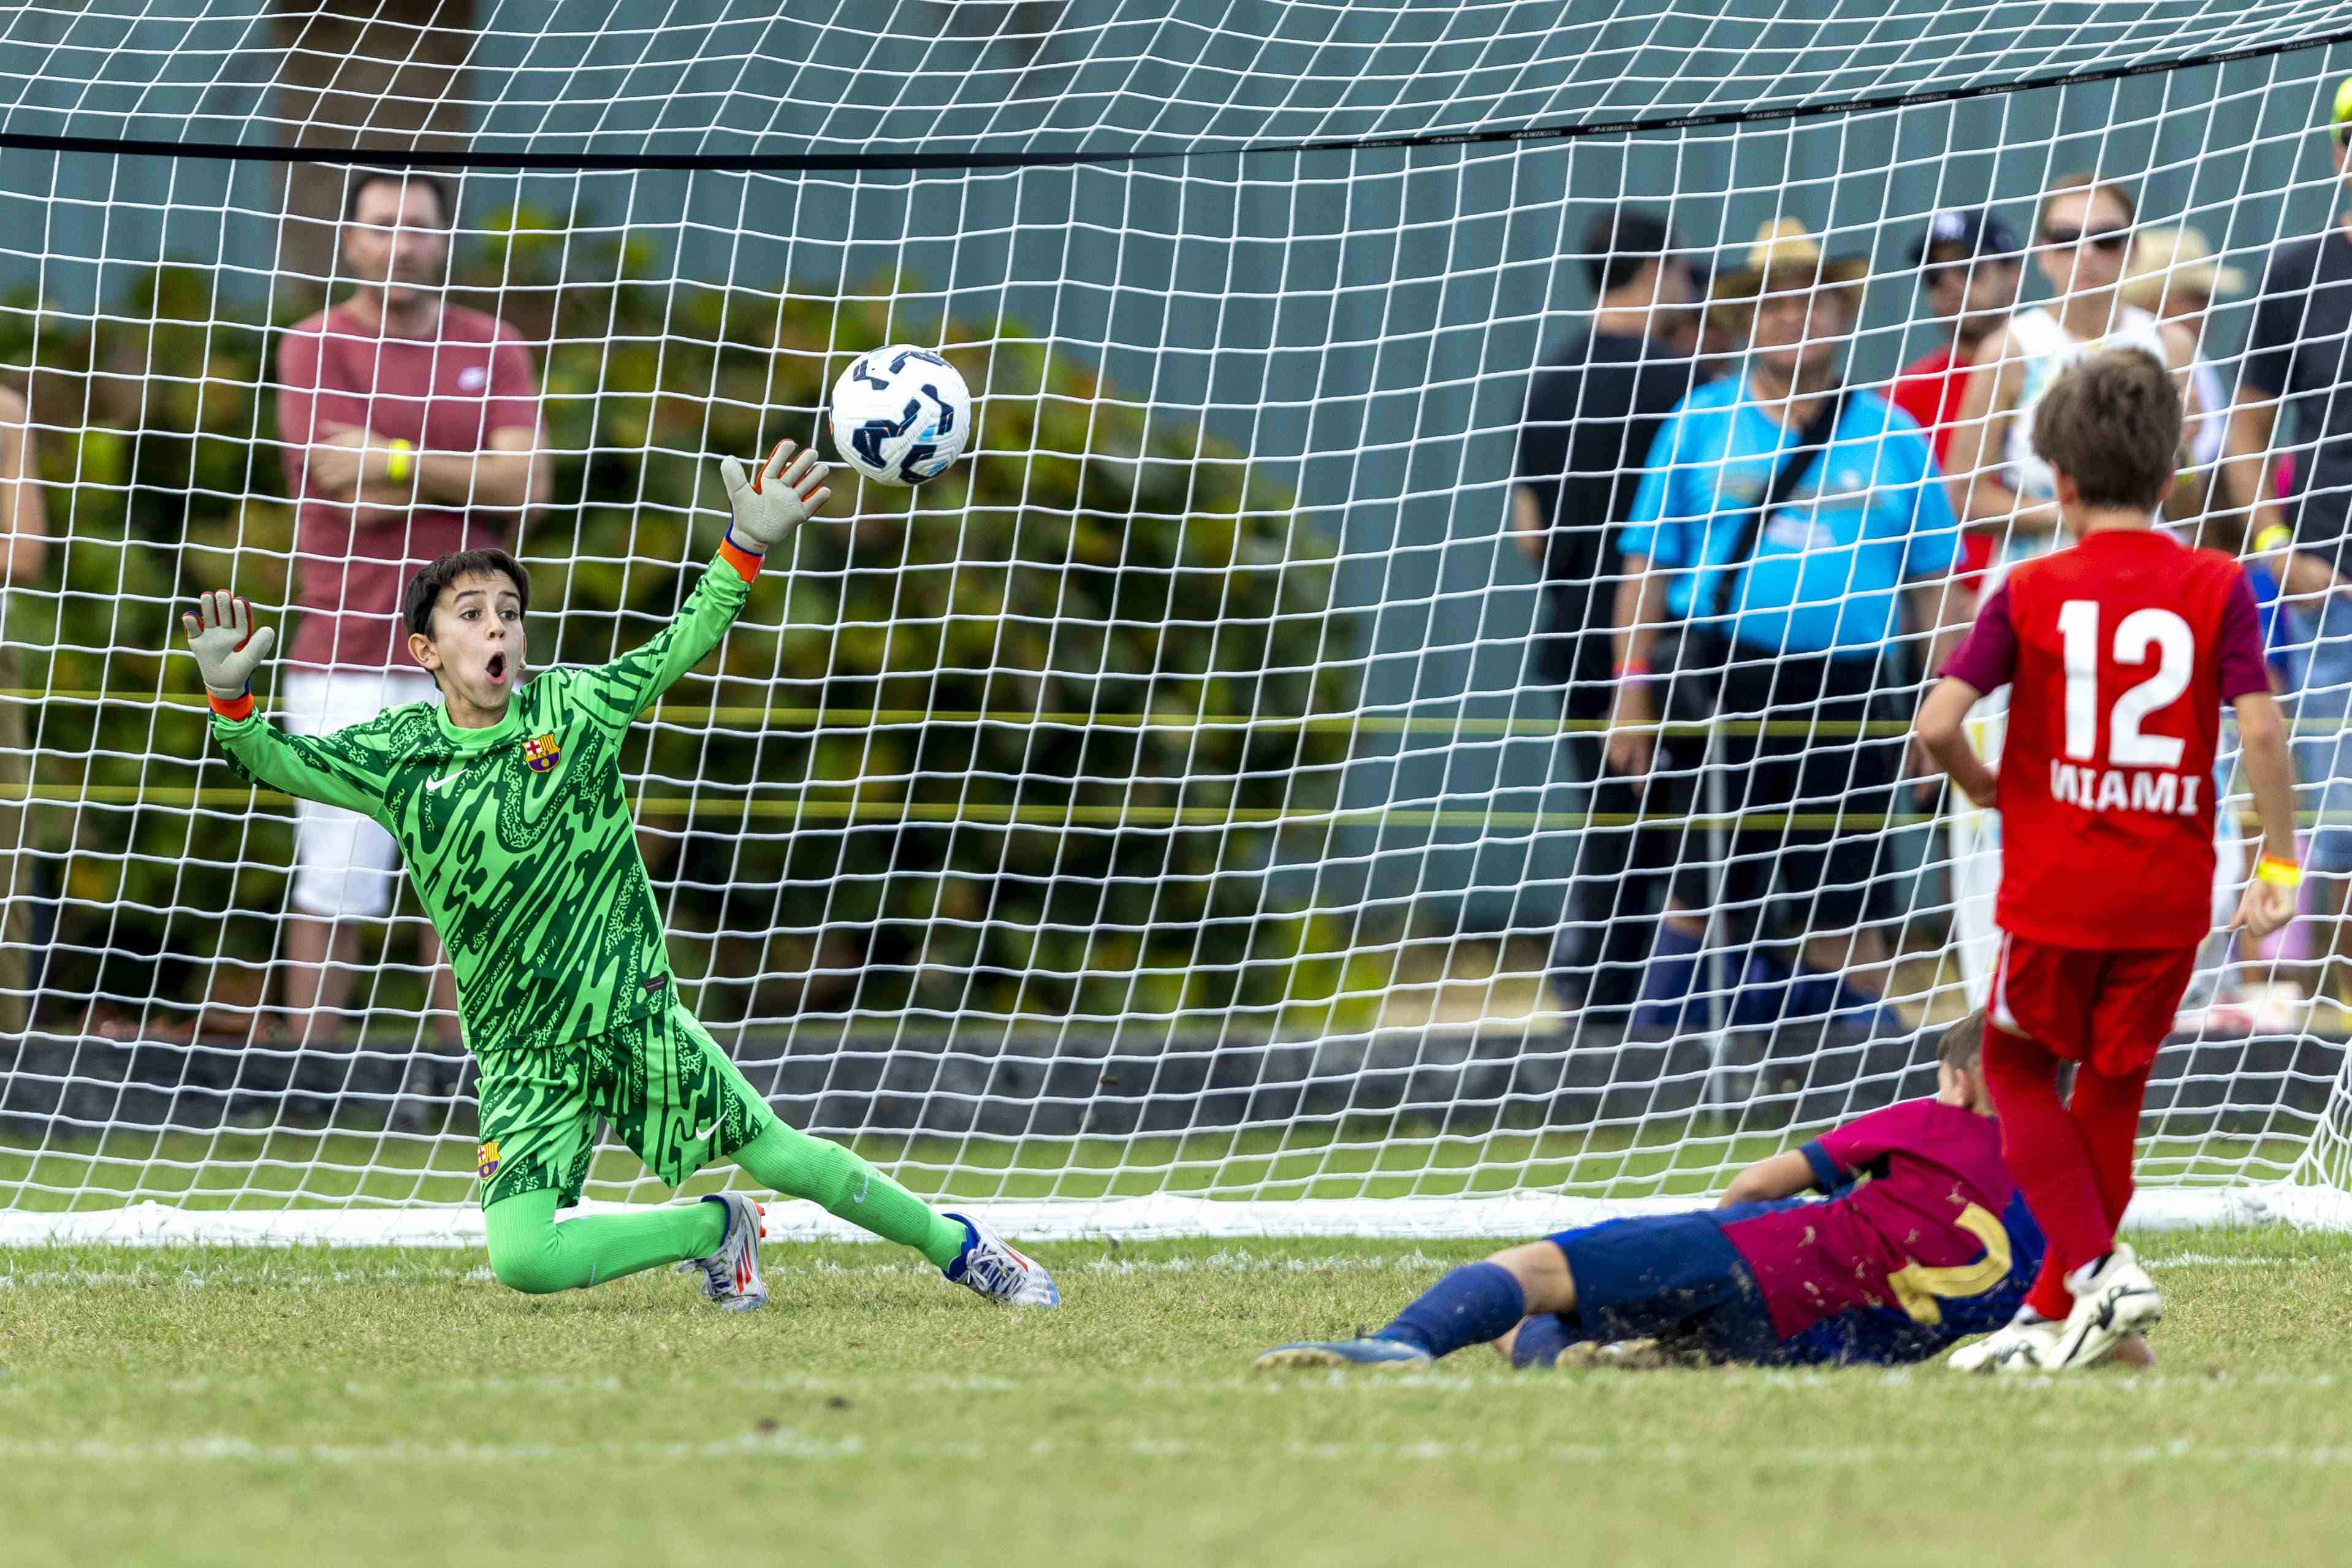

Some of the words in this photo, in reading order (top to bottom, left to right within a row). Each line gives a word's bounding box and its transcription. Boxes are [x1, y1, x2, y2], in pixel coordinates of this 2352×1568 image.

[1521, 129, 1561, 138] KWIKGOAL
[1600, 123, 1638, 132] KWIKGOAL
[2057, 599, 2195, 769] 12
[2050, 758, 2201, 815] MIAMI
